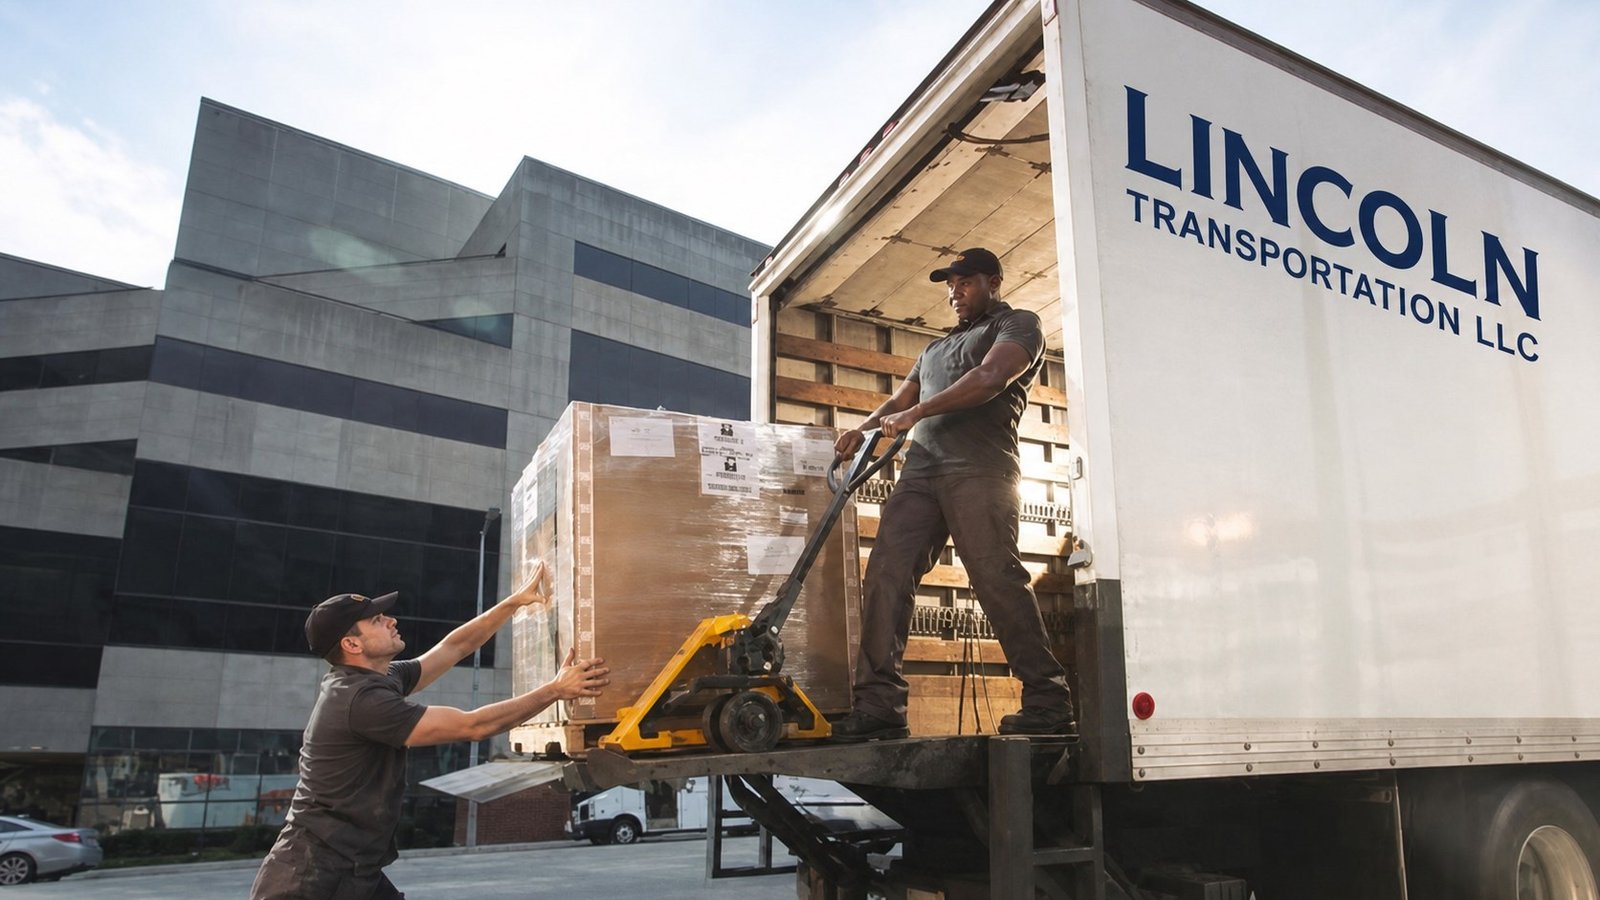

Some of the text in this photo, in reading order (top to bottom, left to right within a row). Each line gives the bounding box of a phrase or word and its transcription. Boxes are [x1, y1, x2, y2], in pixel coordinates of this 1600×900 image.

[1124, 85, 1541, 321] LINCOLN
[1126, 188, 1540, 363] TRANSPORTATION LLC
